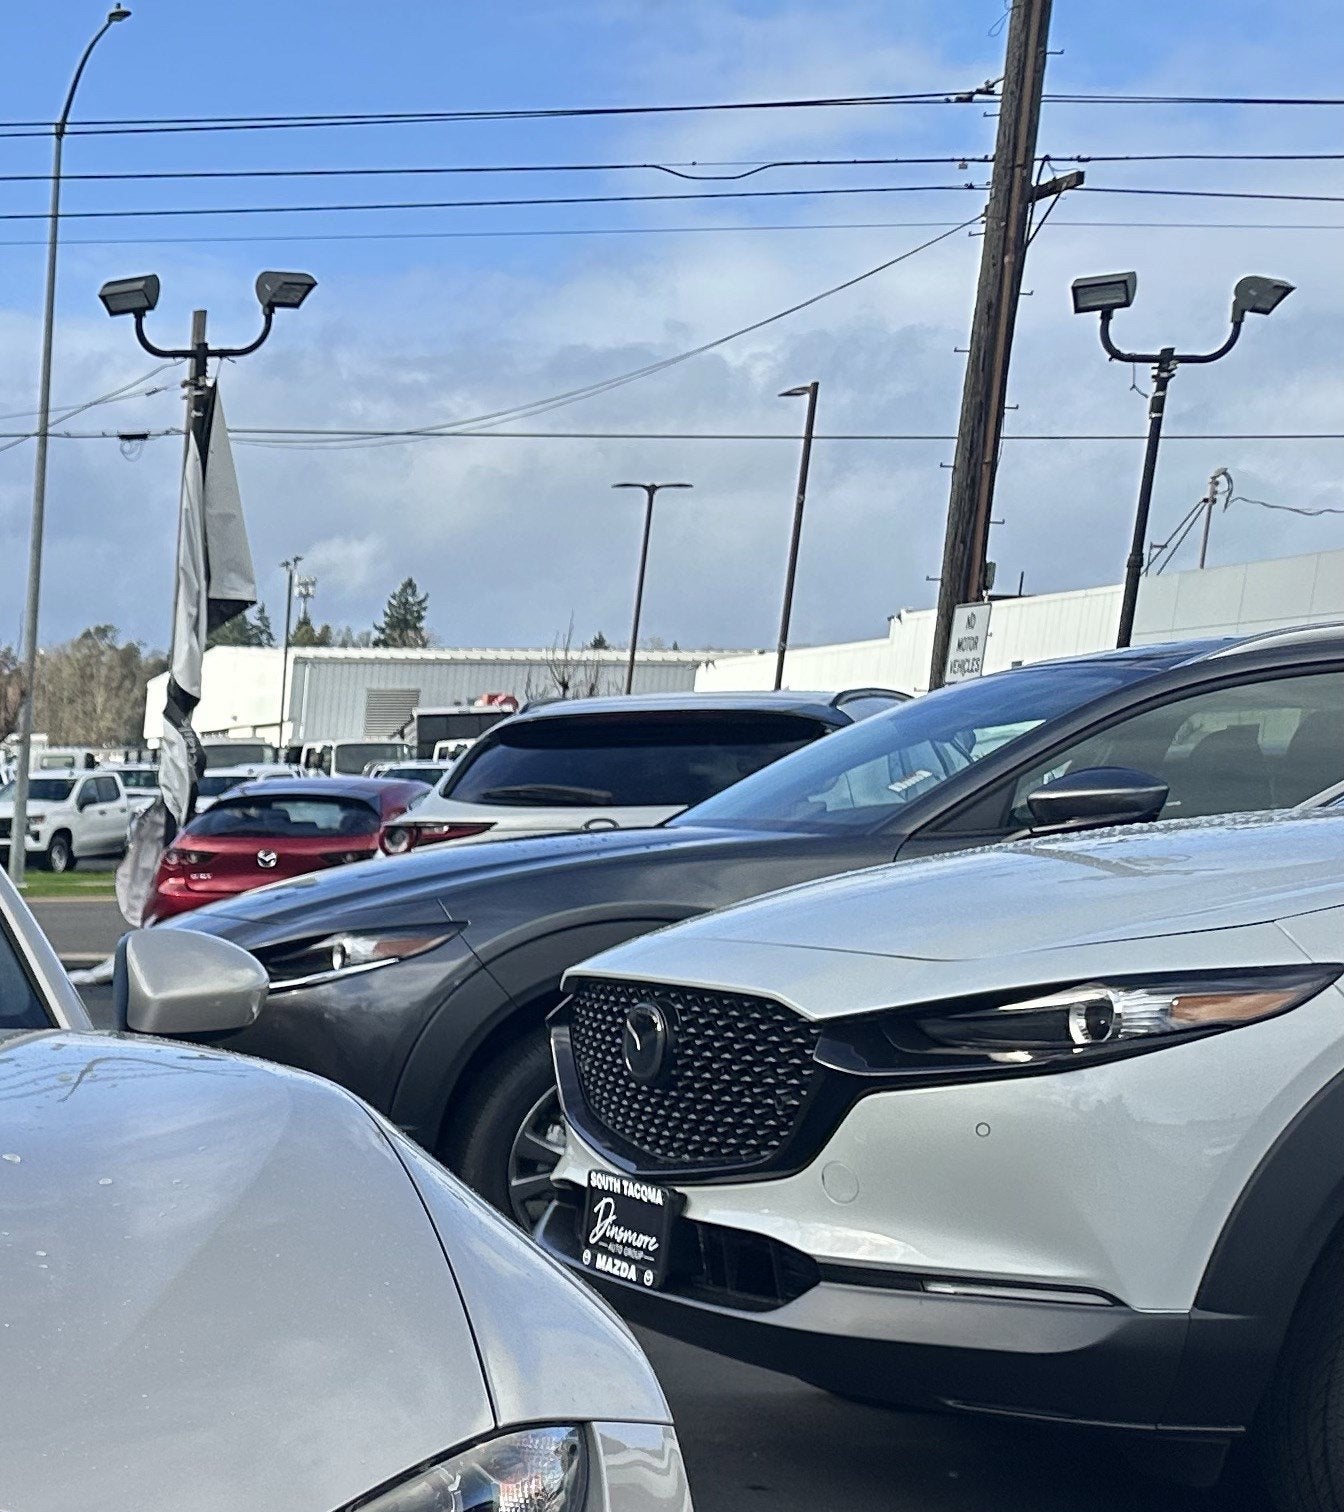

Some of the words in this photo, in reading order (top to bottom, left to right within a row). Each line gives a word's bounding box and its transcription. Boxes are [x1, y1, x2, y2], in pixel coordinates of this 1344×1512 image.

[590, 1171, 621, 1194] SOUTH
[622, 1179, 663, 1206] TACOMA
[589, 1197, 660, 1252] Dinsmore
[595, 1252, 637, 1282] MAZDA
